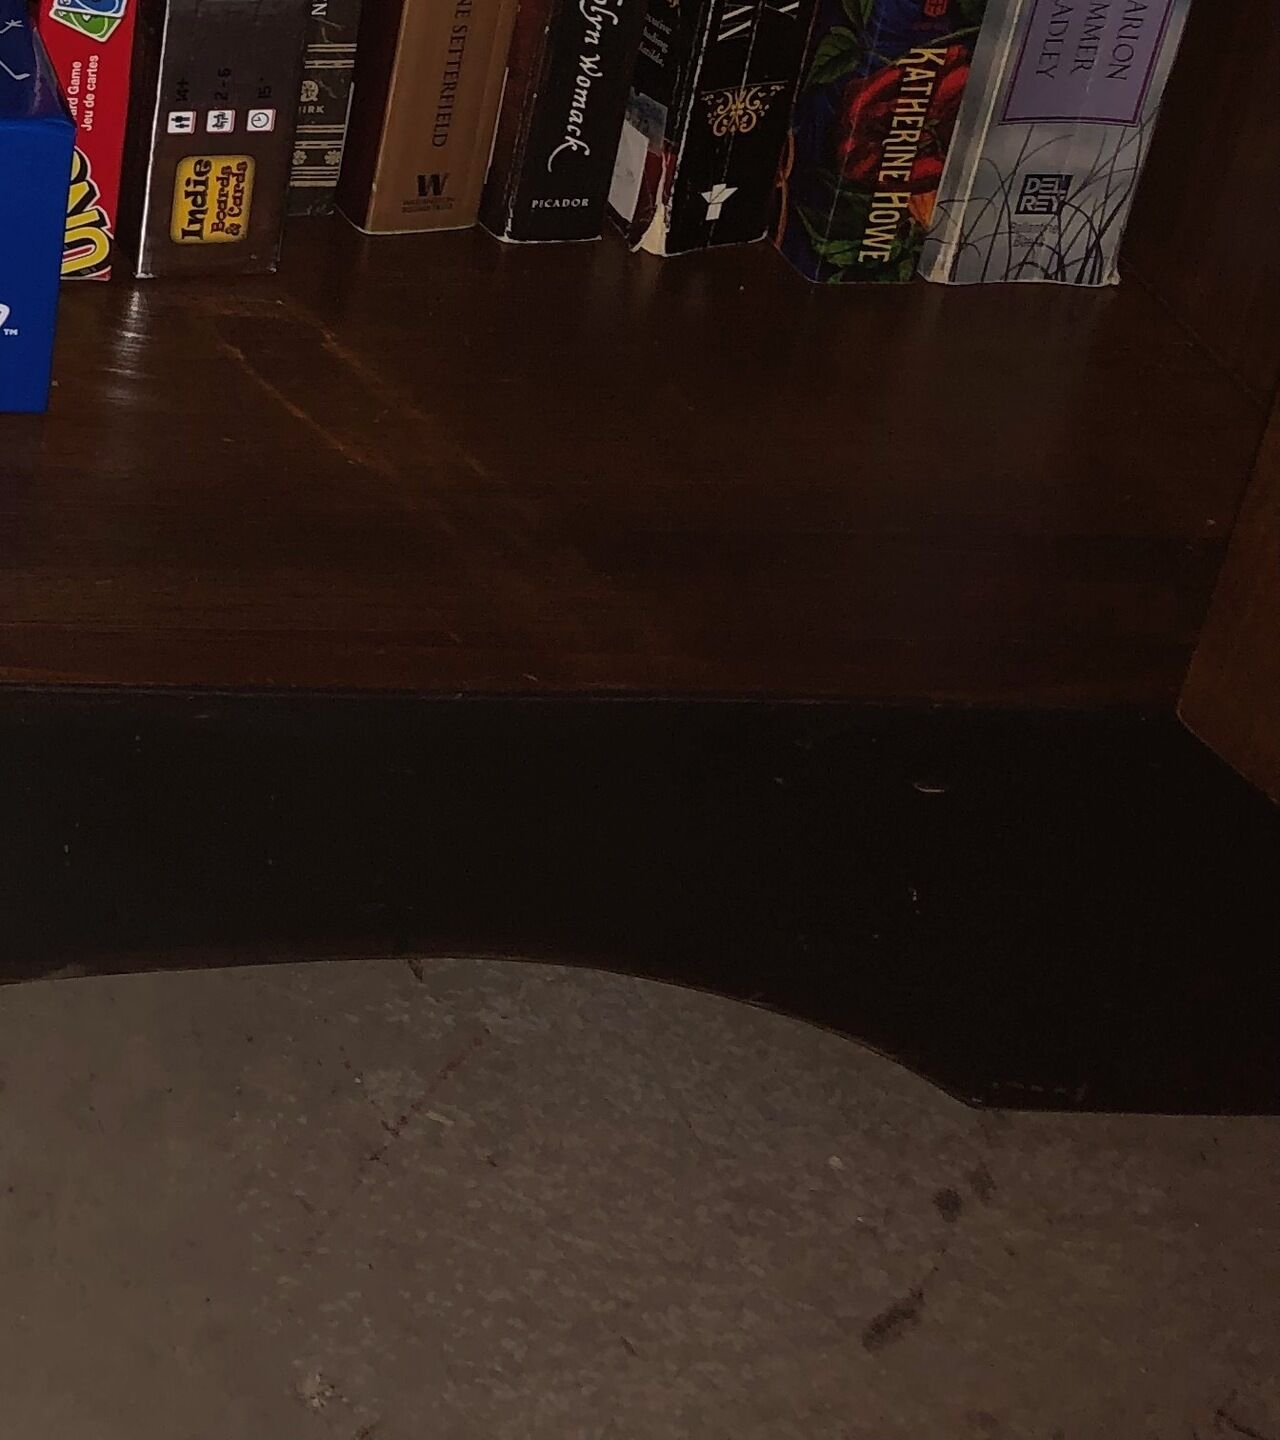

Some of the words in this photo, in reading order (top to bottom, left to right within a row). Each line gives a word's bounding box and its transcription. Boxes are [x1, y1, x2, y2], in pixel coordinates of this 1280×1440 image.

[70, 61, 83, 96] Game
[81, 109, 94, 132] Jeu
[88, 55, 100, 91] cartes
[431, 24, 468, 150] SETTERFIELD
[548, 53, 603, 173] Womack
[877, 45, 947, 185] KATHERINE
[181, 158, 213, 241] Indie
[209, 165, 233, 235] Boards
[228, 160, 249, 218] Cards
[531, 196, 590, 210] PICADOR
[1019, 194, 1068, 213] REY
[1024, 176, 1068, 194] DEL
[857, 192, 913, 264] HOWE
